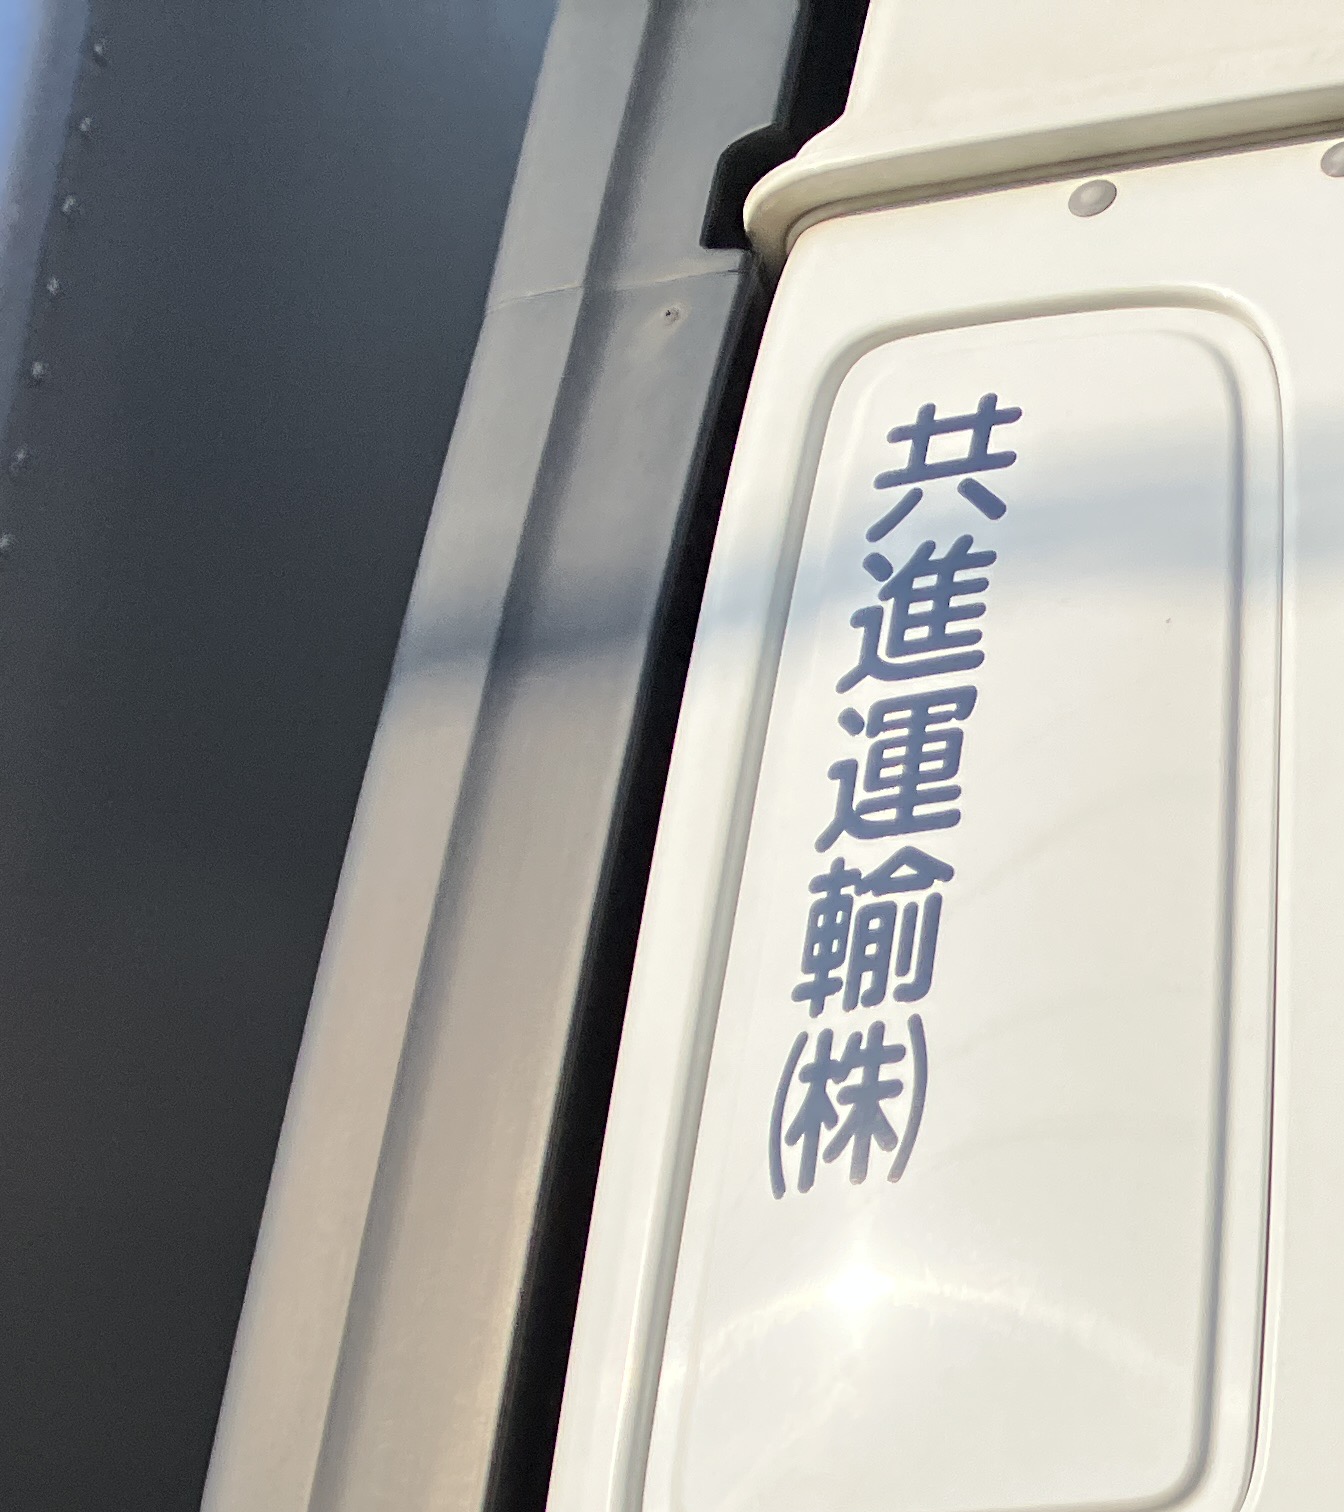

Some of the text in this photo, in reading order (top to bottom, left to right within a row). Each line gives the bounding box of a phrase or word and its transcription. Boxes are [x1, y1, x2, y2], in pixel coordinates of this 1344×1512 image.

[768, 392, 1022, 1199] 共進運輸(株)
